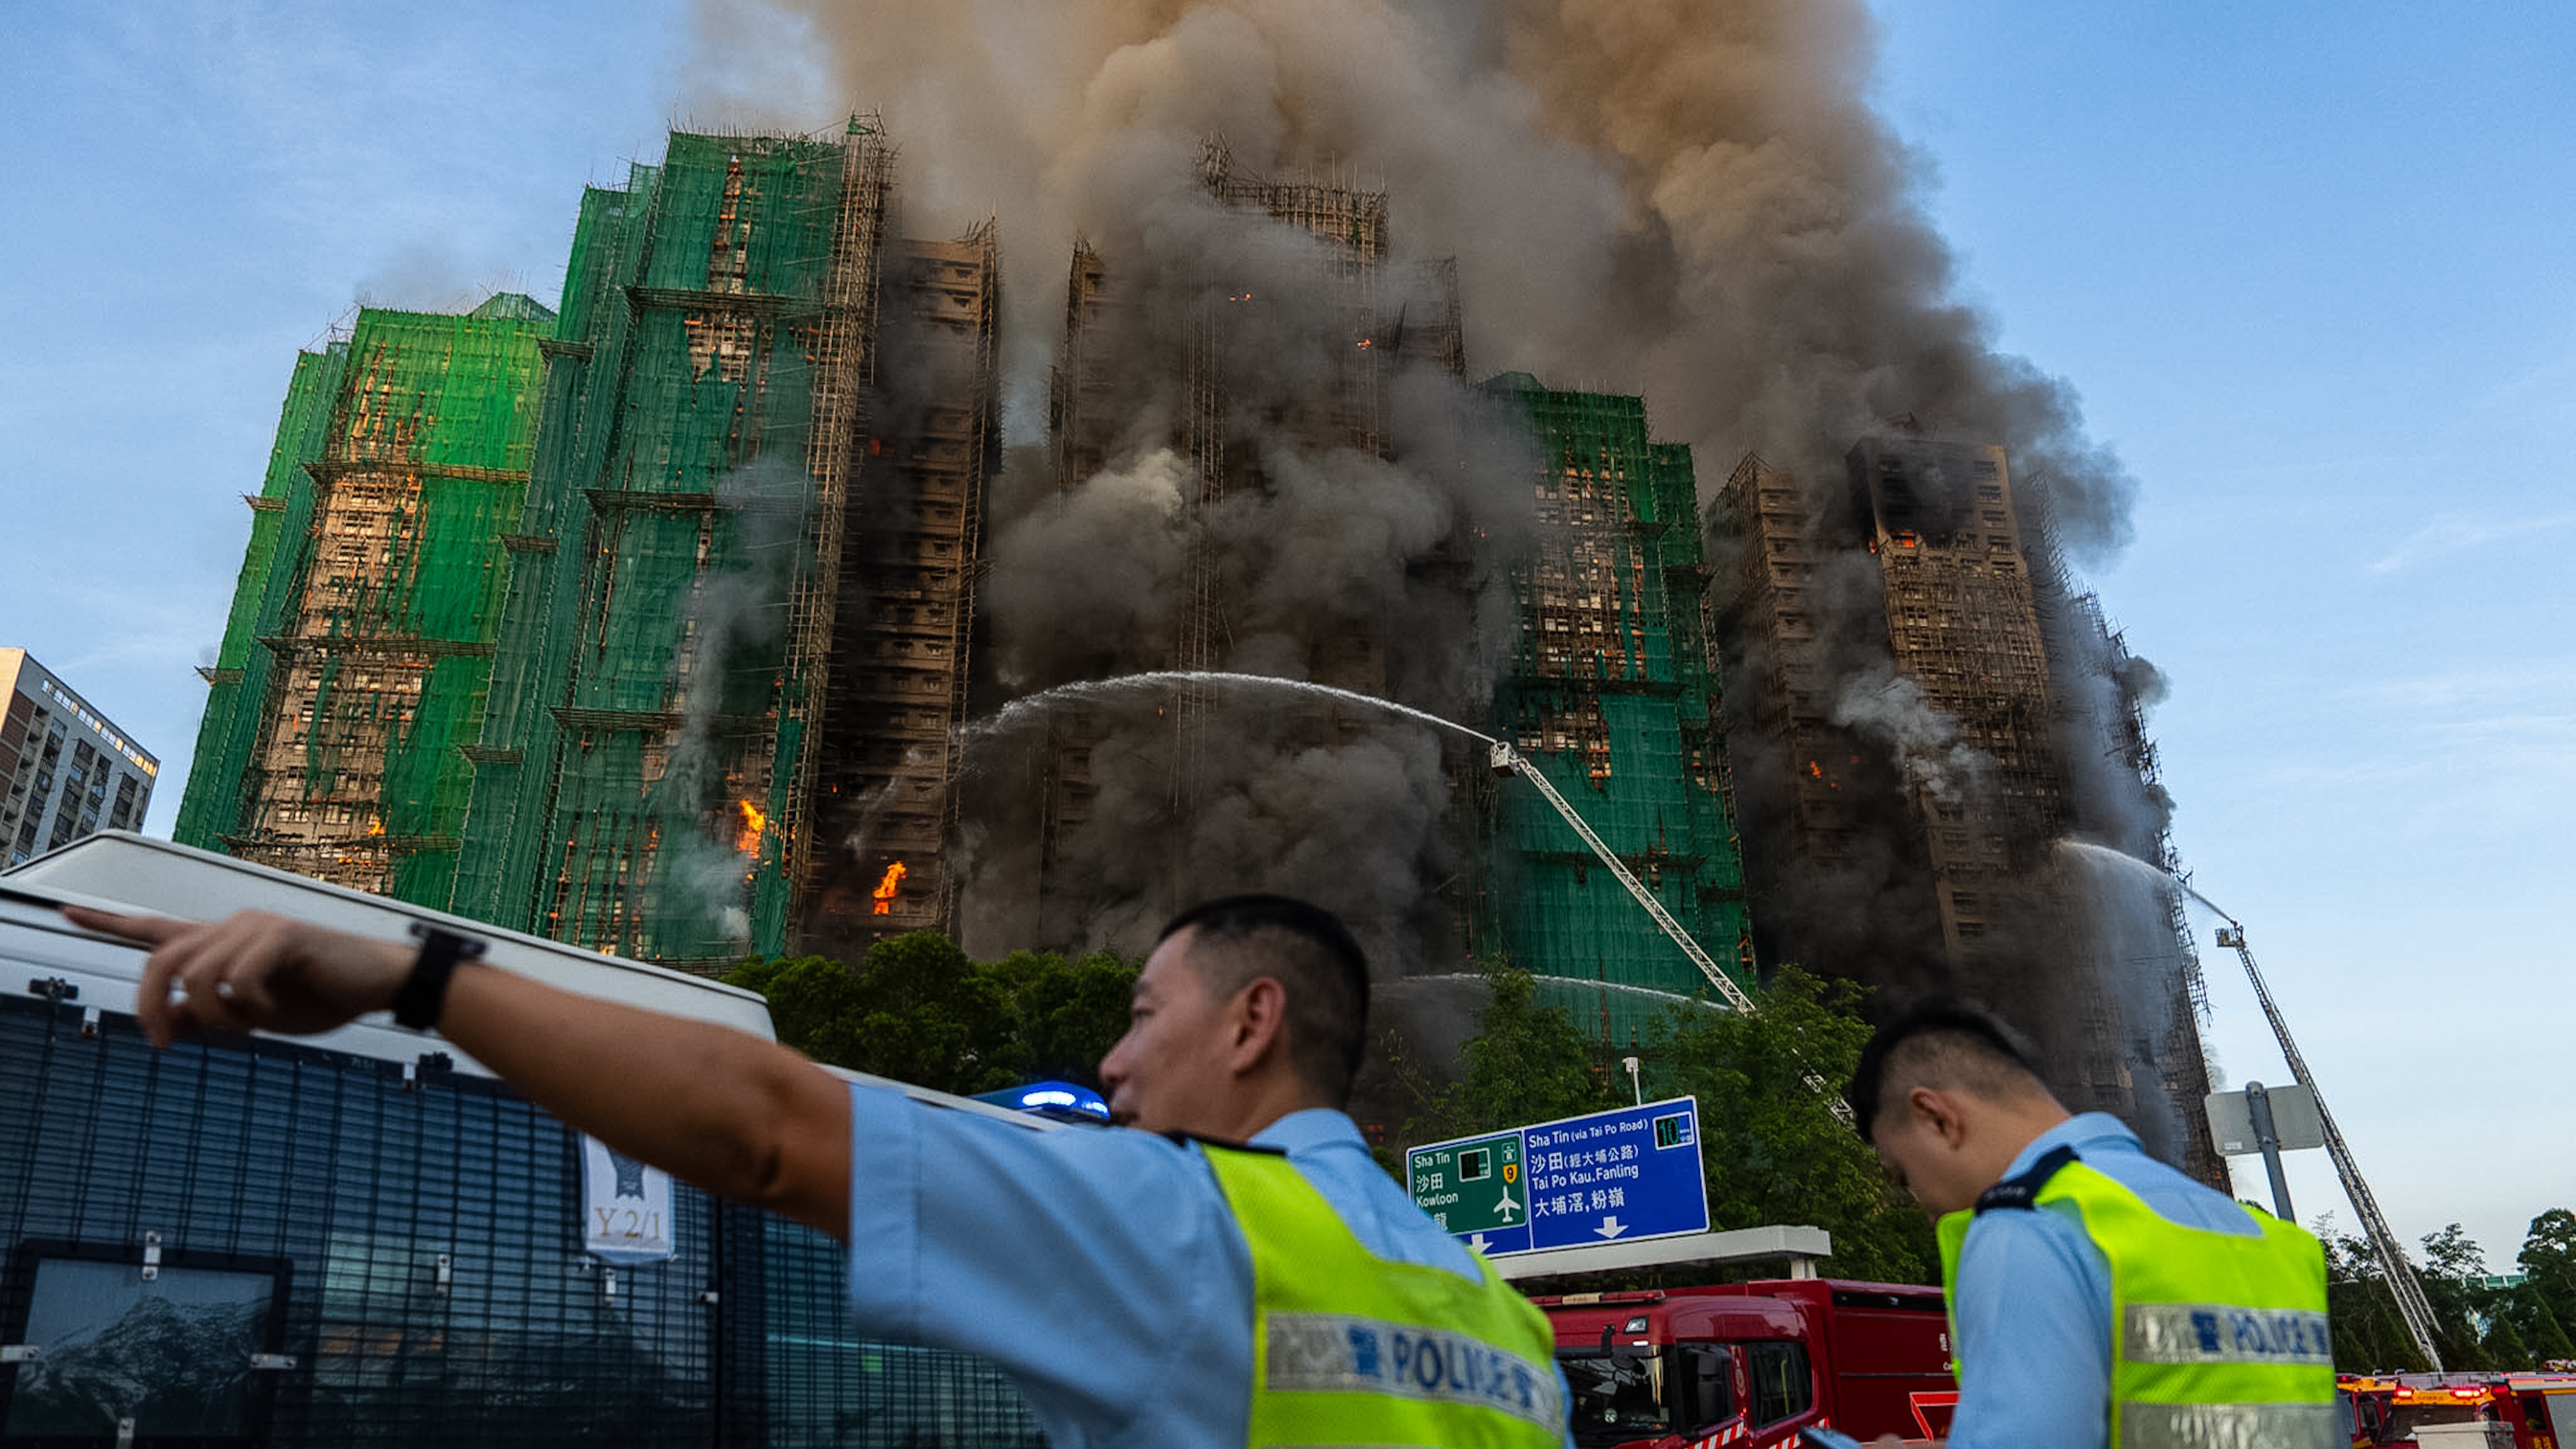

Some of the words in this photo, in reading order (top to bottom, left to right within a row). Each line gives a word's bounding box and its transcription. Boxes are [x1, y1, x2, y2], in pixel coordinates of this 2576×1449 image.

[1528, 1134, 1550, 1148] Sha
[1552, 1130, 1570, 1144] Tin
[1571, 1130, 1588, 1142] (via
[1589, 1126, 1603, 1138] Tai
[1605, 1124, 1617, 1135] Po
[1619, 1118, 1649, 1132] Road)
[1659, 1119, 1680, 1145] 10
[1414, 1155, 1433, 1169] Sha
[1435, 1152, 1451, 1164] Tin
[1507, 1166, 1515, 1180] 9
[1416, 1172, 1444, 1193] 沙田
[1532, 1175, 1549, 1191] Tai
[1551, 1174, 1567, 1189] Po
[1595, 1164, 1639, 1181] Fanling
[1416, 1193, 1459, 1209] Kowloon
[595, 1207, 617, 1237] Y
[1393, 1332, 1511, 1401] POLICE
